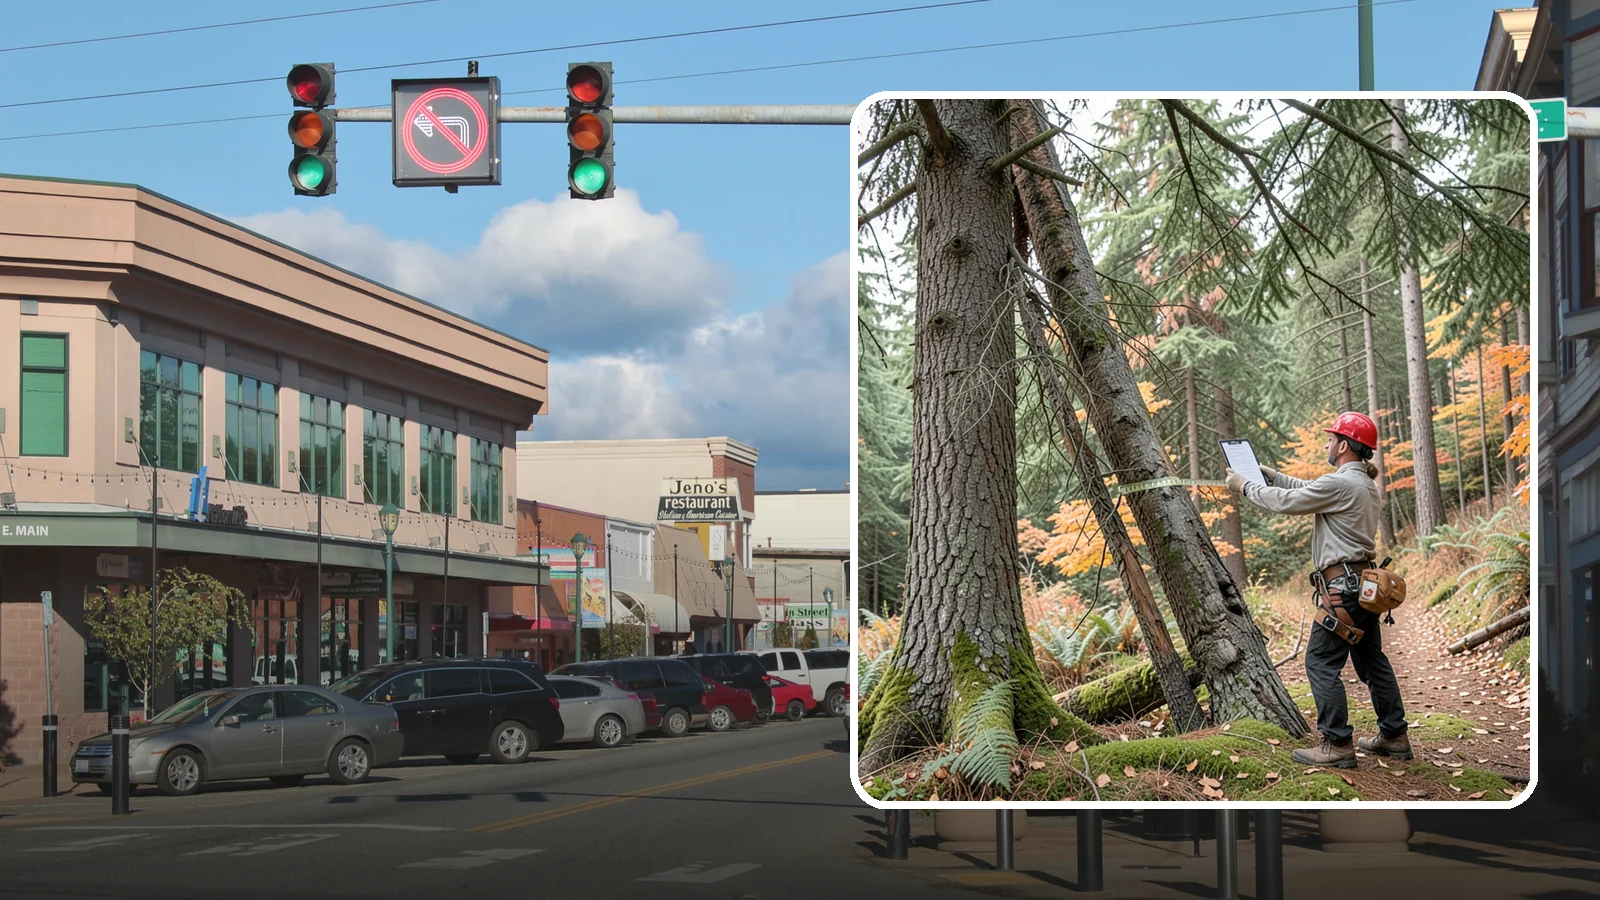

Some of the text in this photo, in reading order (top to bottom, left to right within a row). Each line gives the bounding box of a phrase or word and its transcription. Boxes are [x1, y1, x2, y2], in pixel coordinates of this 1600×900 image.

[669, 480, 727, 495] Jeno's
[665, 496, 731, 509] restaurant
[659, 509, 682, 520] Italian
[686, 509, 715, 520] American
[715, 509, 738, 520] Cuisine
[2, 525, 49, 536] E. MAIN
[797, 607, 828, 617] Street
[789, 619, 824, 627] lass
